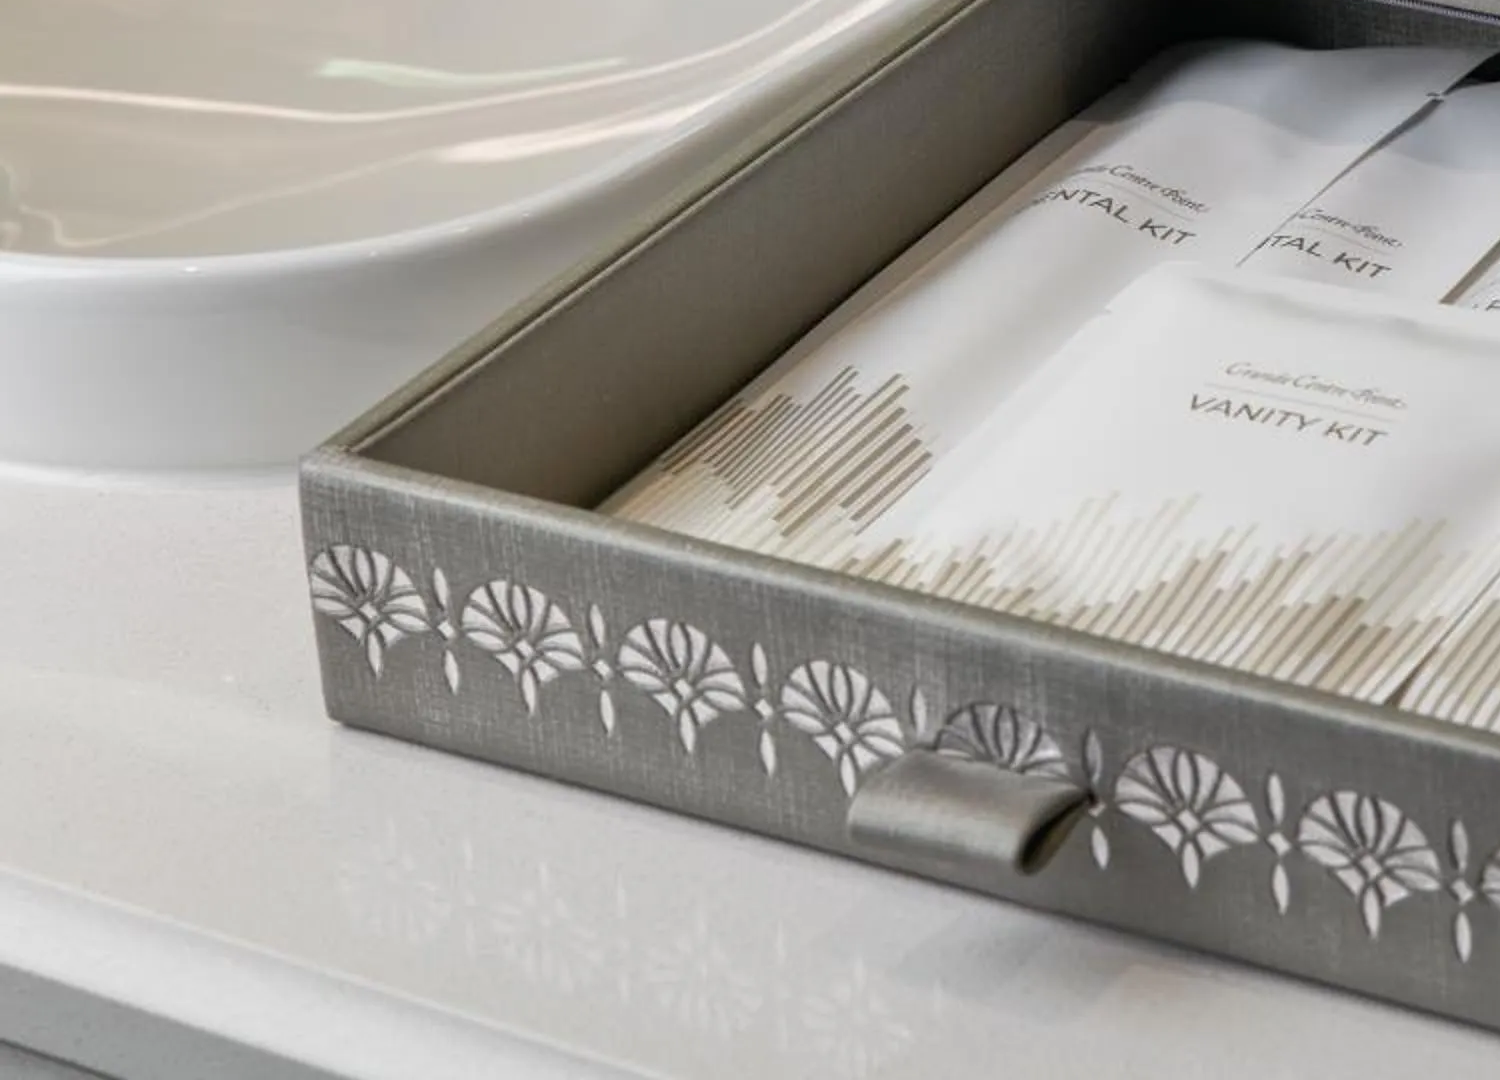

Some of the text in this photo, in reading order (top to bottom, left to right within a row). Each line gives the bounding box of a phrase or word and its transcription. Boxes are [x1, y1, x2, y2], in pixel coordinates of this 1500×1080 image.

[1138, 217, 1197, 245] KIT
[1269, 234, 1393, 278] TAL KIT
[1189, 393, 1389, 446] VANITY KIT
